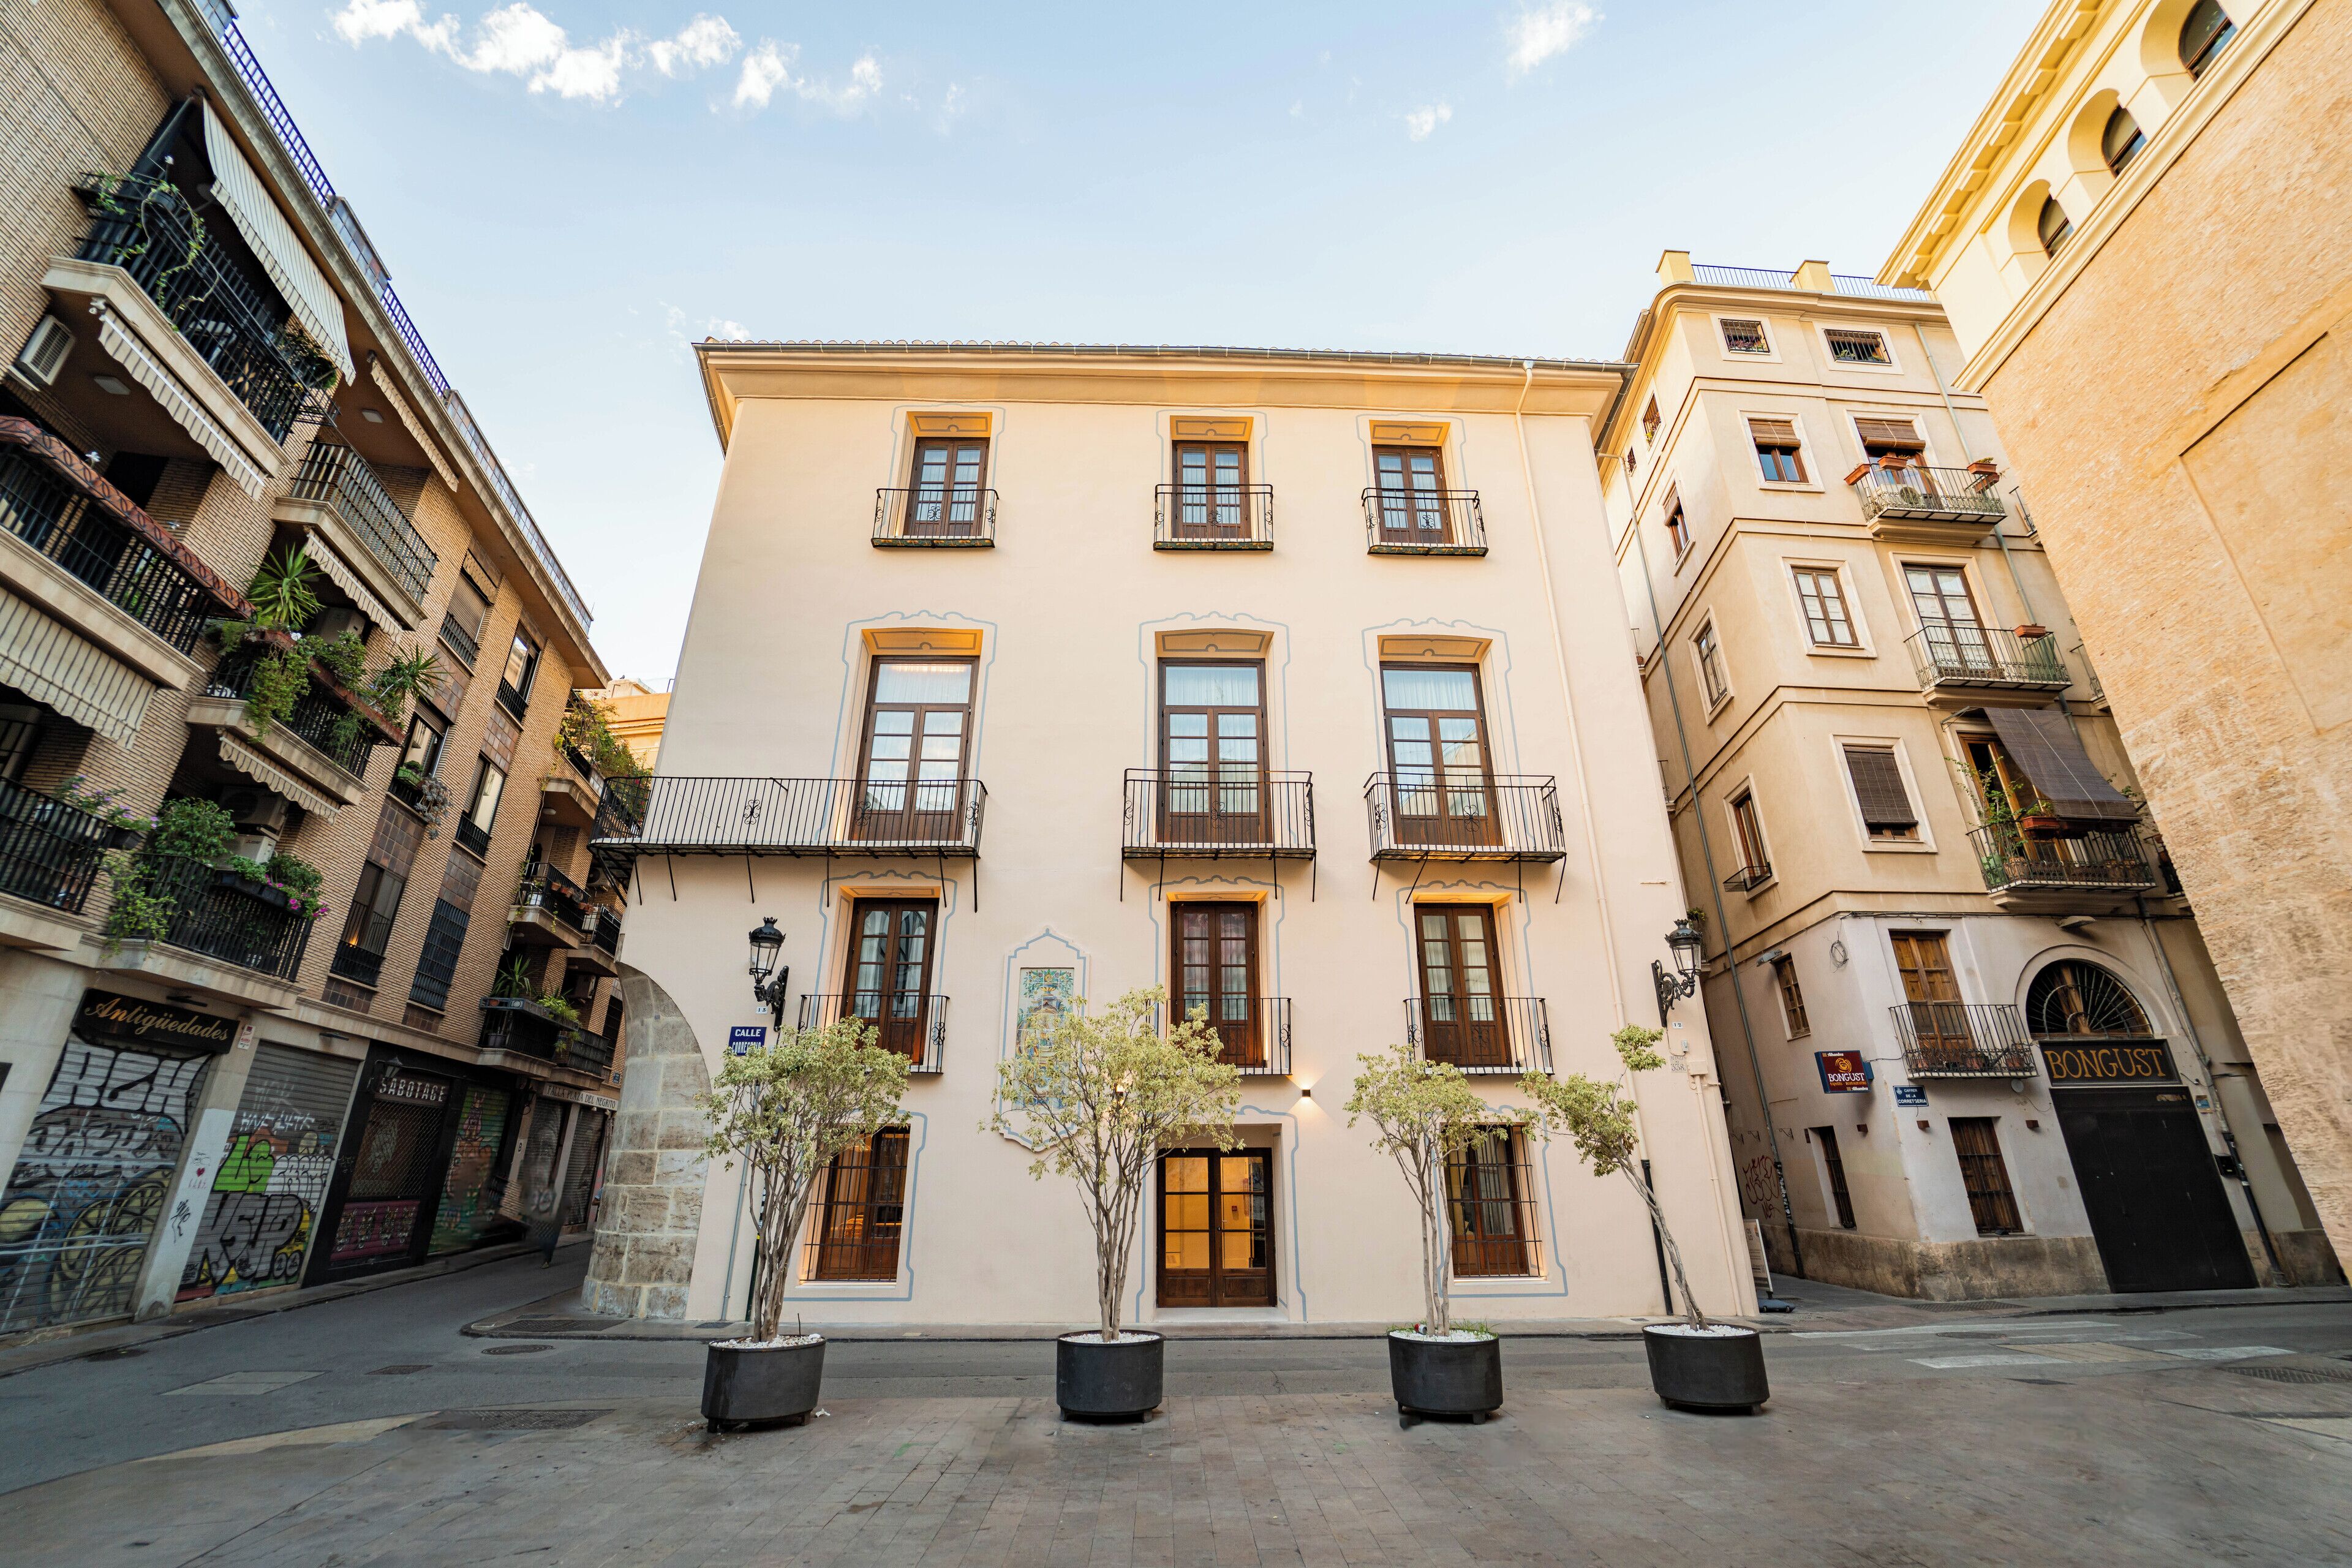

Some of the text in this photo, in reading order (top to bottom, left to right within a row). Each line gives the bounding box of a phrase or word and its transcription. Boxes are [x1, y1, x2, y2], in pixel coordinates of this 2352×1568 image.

[85, 998, 228, 1041] Antigüedades
[2045, 1048, 2166, 1079] BONGUST
[1828, 1072, 1865, 1082] BONGUST
[379, 1078, 446, 1102] SABOTAGE
[567, 1091, 583, 1102] PLAZA
[584, 1094, 594, 1104] DEL
[596, 1097, 616, 1109] NEGRITO
[518, 1142, 522, 1152] B
